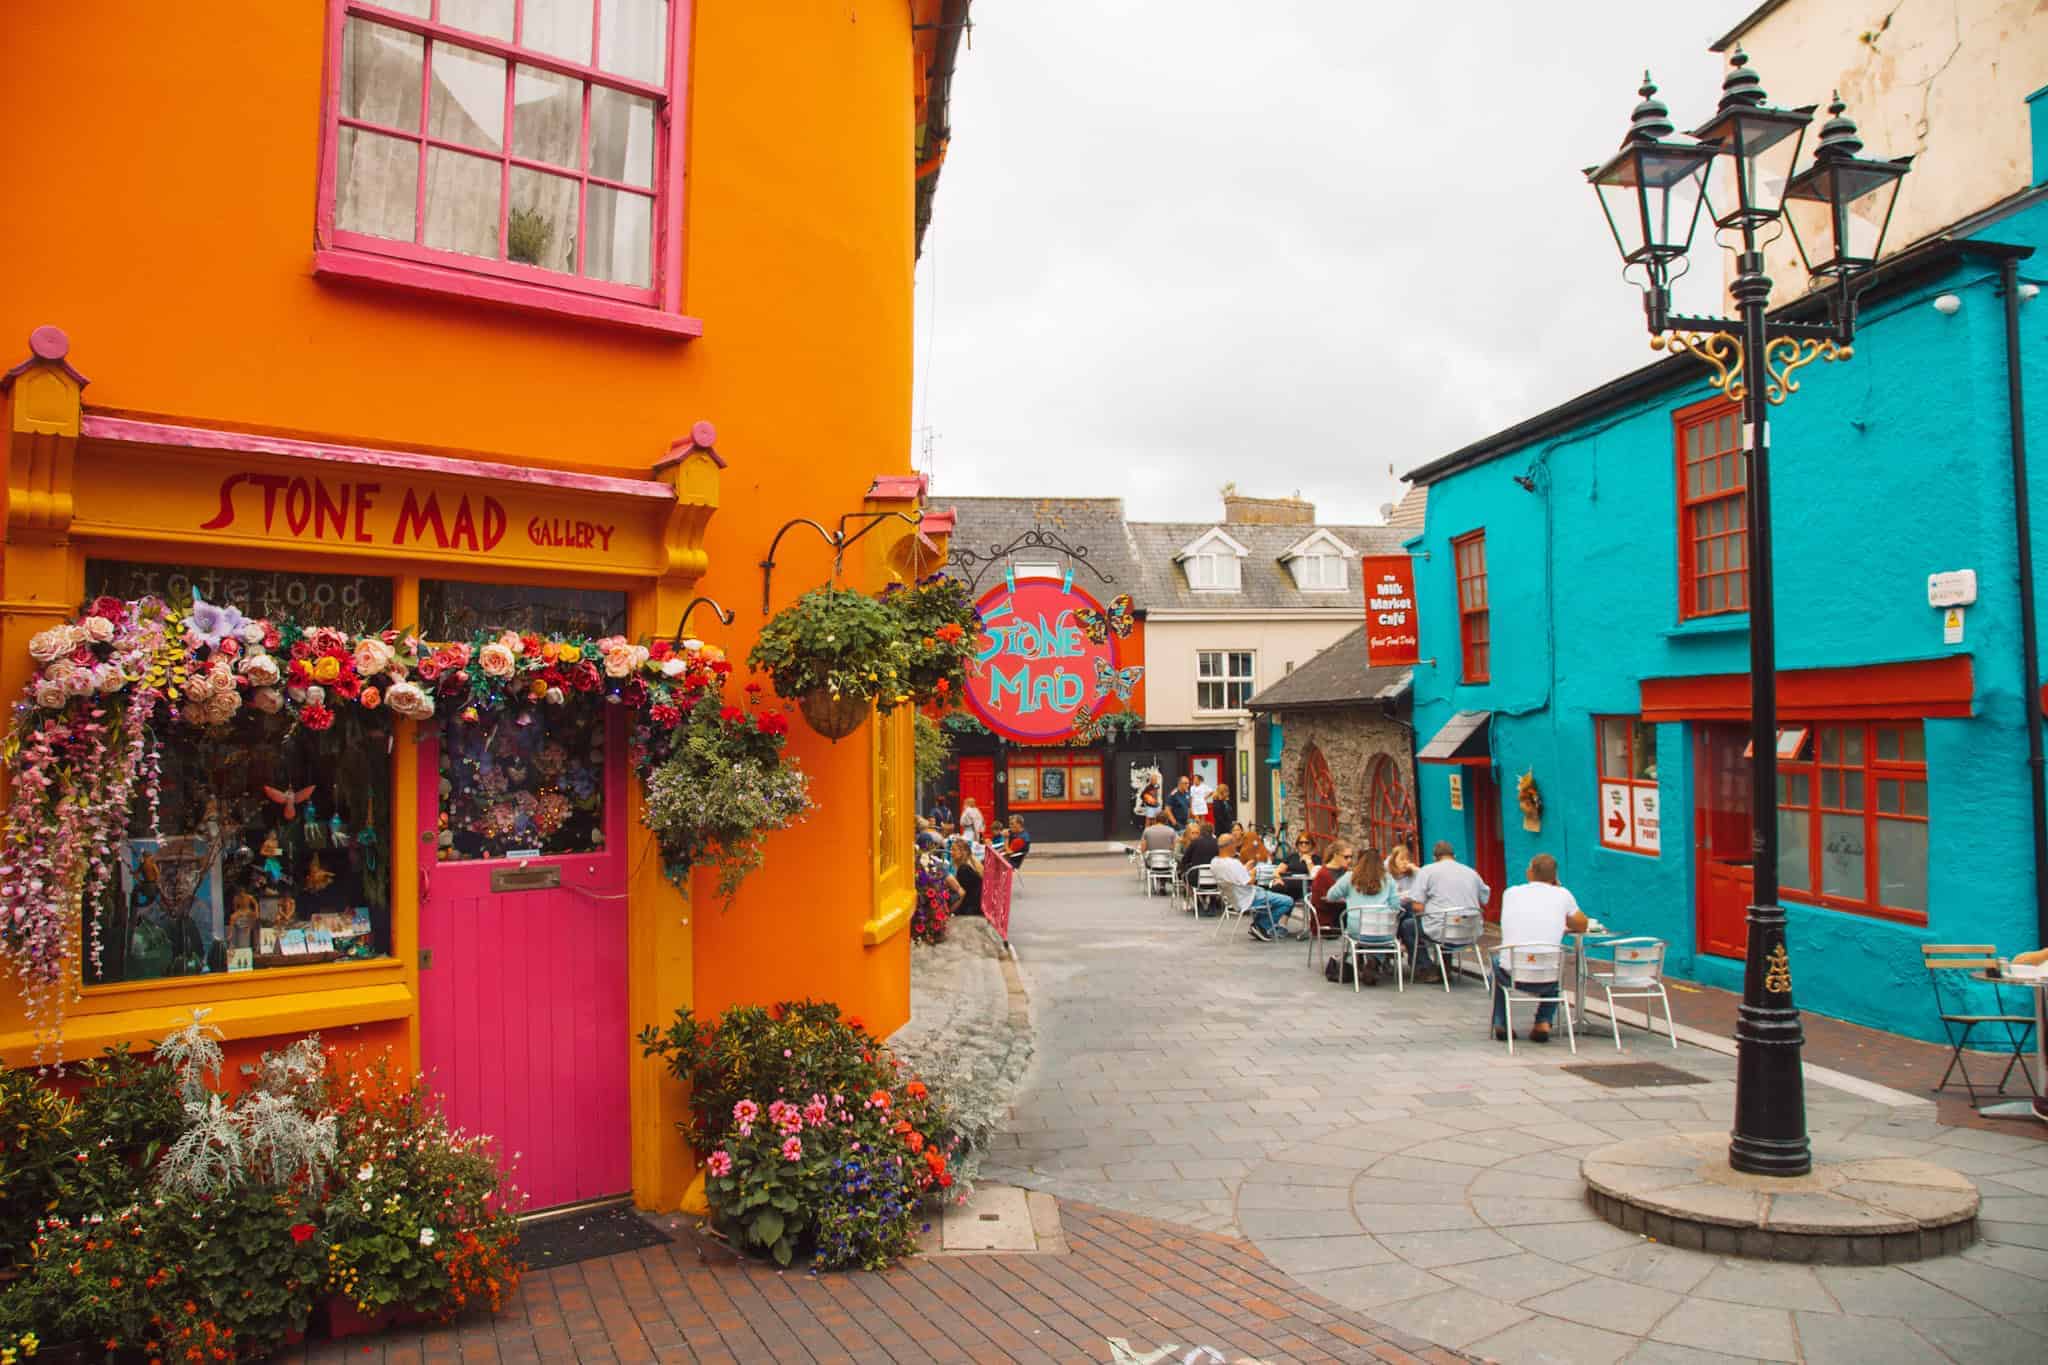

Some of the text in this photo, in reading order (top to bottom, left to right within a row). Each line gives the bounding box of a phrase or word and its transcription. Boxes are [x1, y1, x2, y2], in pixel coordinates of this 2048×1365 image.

[200, 472, 616, 552] STONE MAD GALLERY
[1376, 583, 1404, 596] Milk
[1370, 598, 1412, 610] Market
[1378, 612, 1406, 626] Café
[988, 664, 1085, 716] MAD
